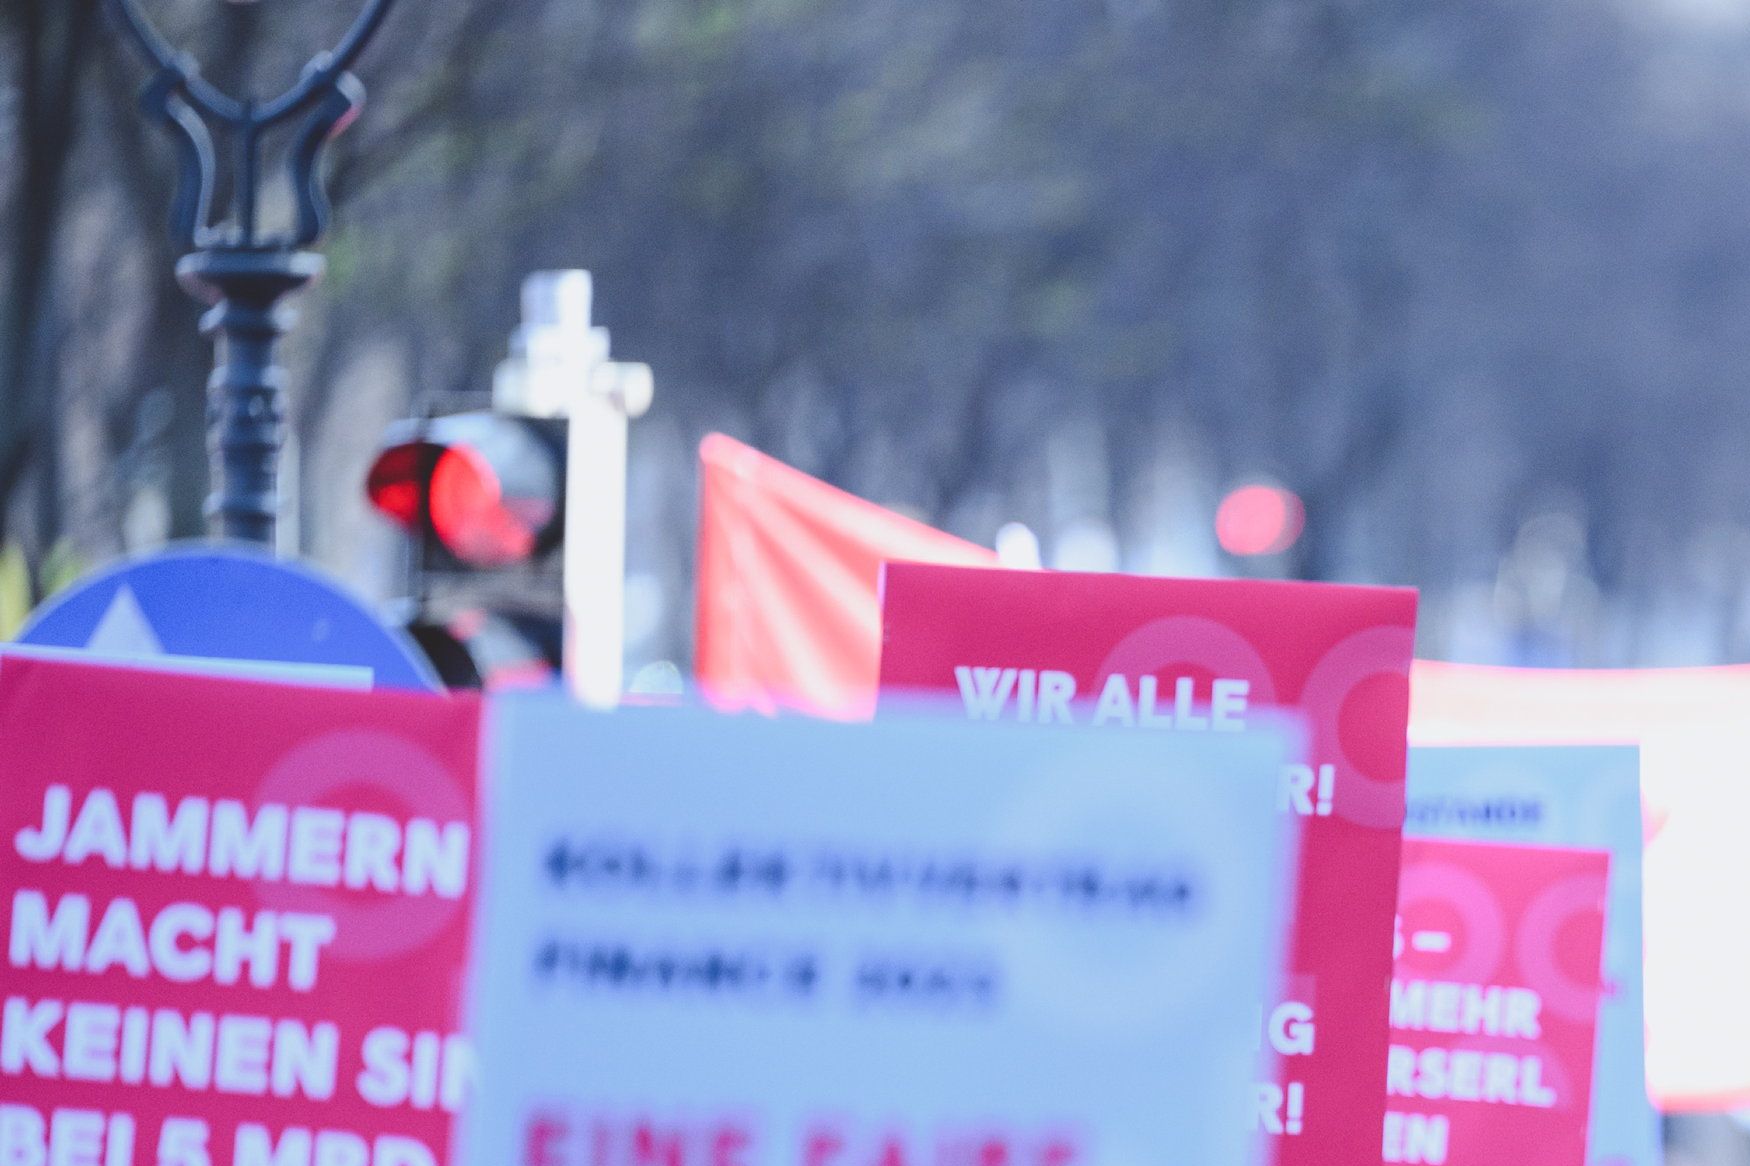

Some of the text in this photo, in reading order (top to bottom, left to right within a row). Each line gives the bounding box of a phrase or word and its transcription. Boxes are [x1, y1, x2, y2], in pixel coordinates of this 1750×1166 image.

[955, 664, 1250, 732] WIR ALLE
[15, 785, 471, 898] JAMMERN
[10, 890, 337, 992] MACHT
[0, 996, 340, 1099] KEINEN
[1389, 979, 1543, 1040] MEHR
